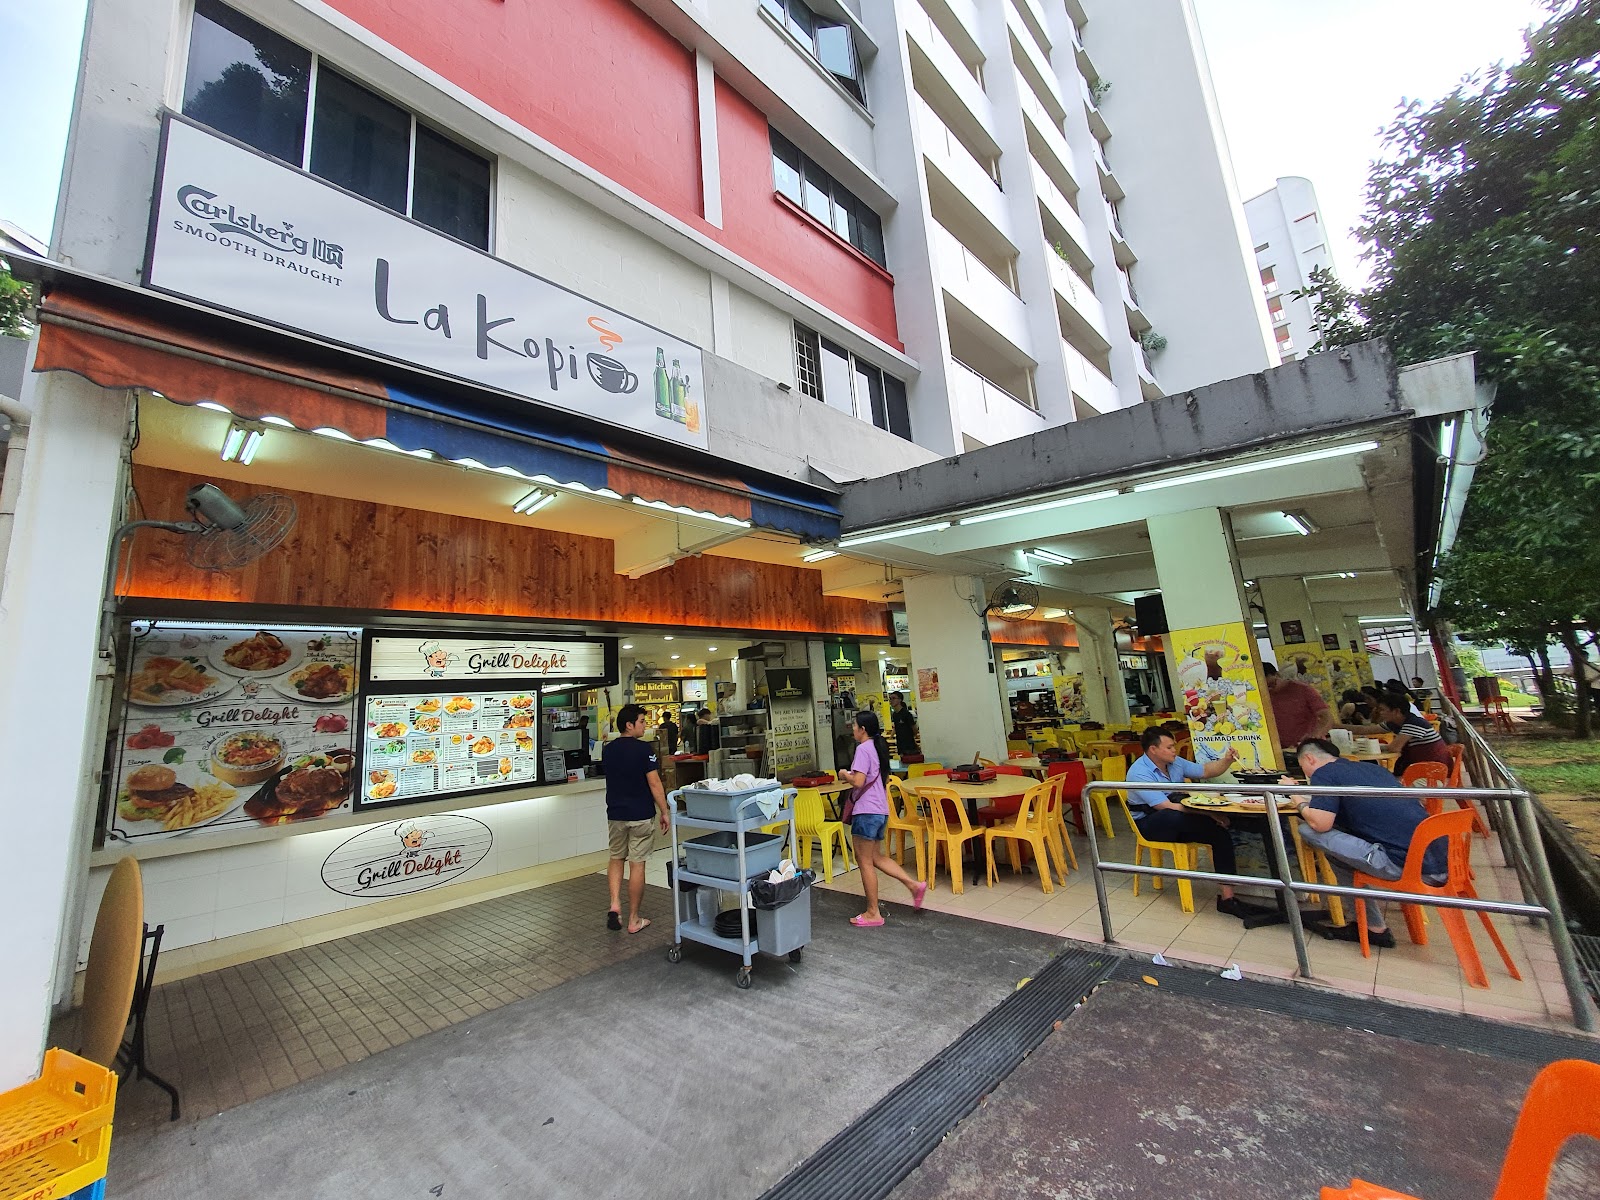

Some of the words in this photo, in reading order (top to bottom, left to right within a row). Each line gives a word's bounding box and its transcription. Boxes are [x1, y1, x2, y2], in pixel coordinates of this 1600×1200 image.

[176, 184, 309, 256] Carlsberg
[173, 220, 257, 257] SMOOTH
[262, 252, 343, 287] DRAUGHT
[375, 258, 452, 339] La
[476, 294, 578, 391] Kopi
[468, 652, 510, 673] Grill
[511, 653, 567, 674] Delight
[196, 708, 240, 727] Grill
[240, 706, 299, 726] Delight
[1193, 735, 1237, 743] HOMEMADE
[357, 860, 402, 889] Grill
[402, 850, 462, 876] Delight
